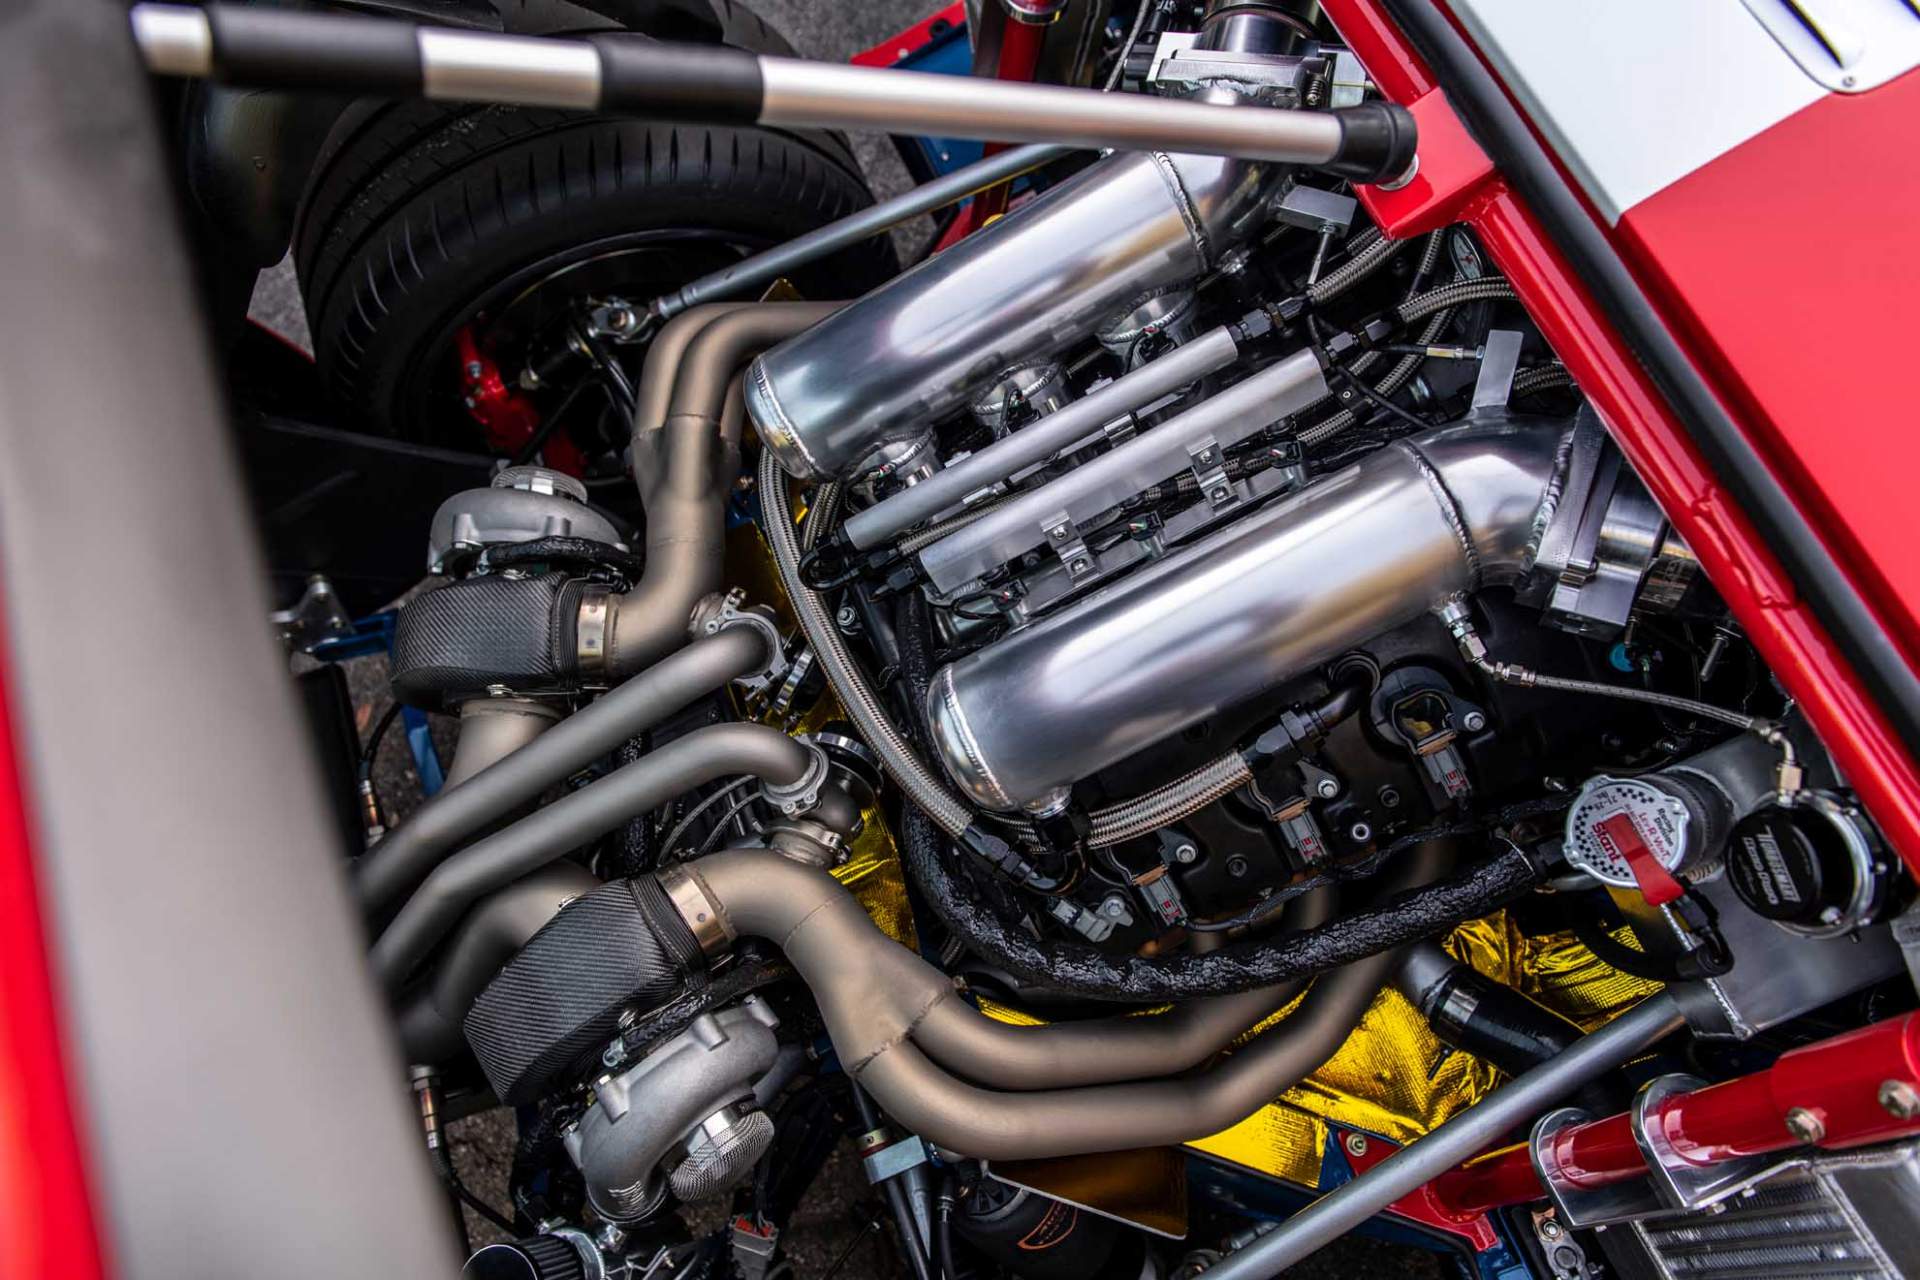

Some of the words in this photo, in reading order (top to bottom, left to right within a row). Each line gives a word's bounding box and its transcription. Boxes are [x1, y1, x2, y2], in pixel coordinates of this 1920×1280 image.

[1654, 816, 1673, 847] Division
[1657, 807, 1675, 834] Racing
[1591, 821, 1620, 862] Stant
[1756, 824, 1801, 902] TURBOSMART
